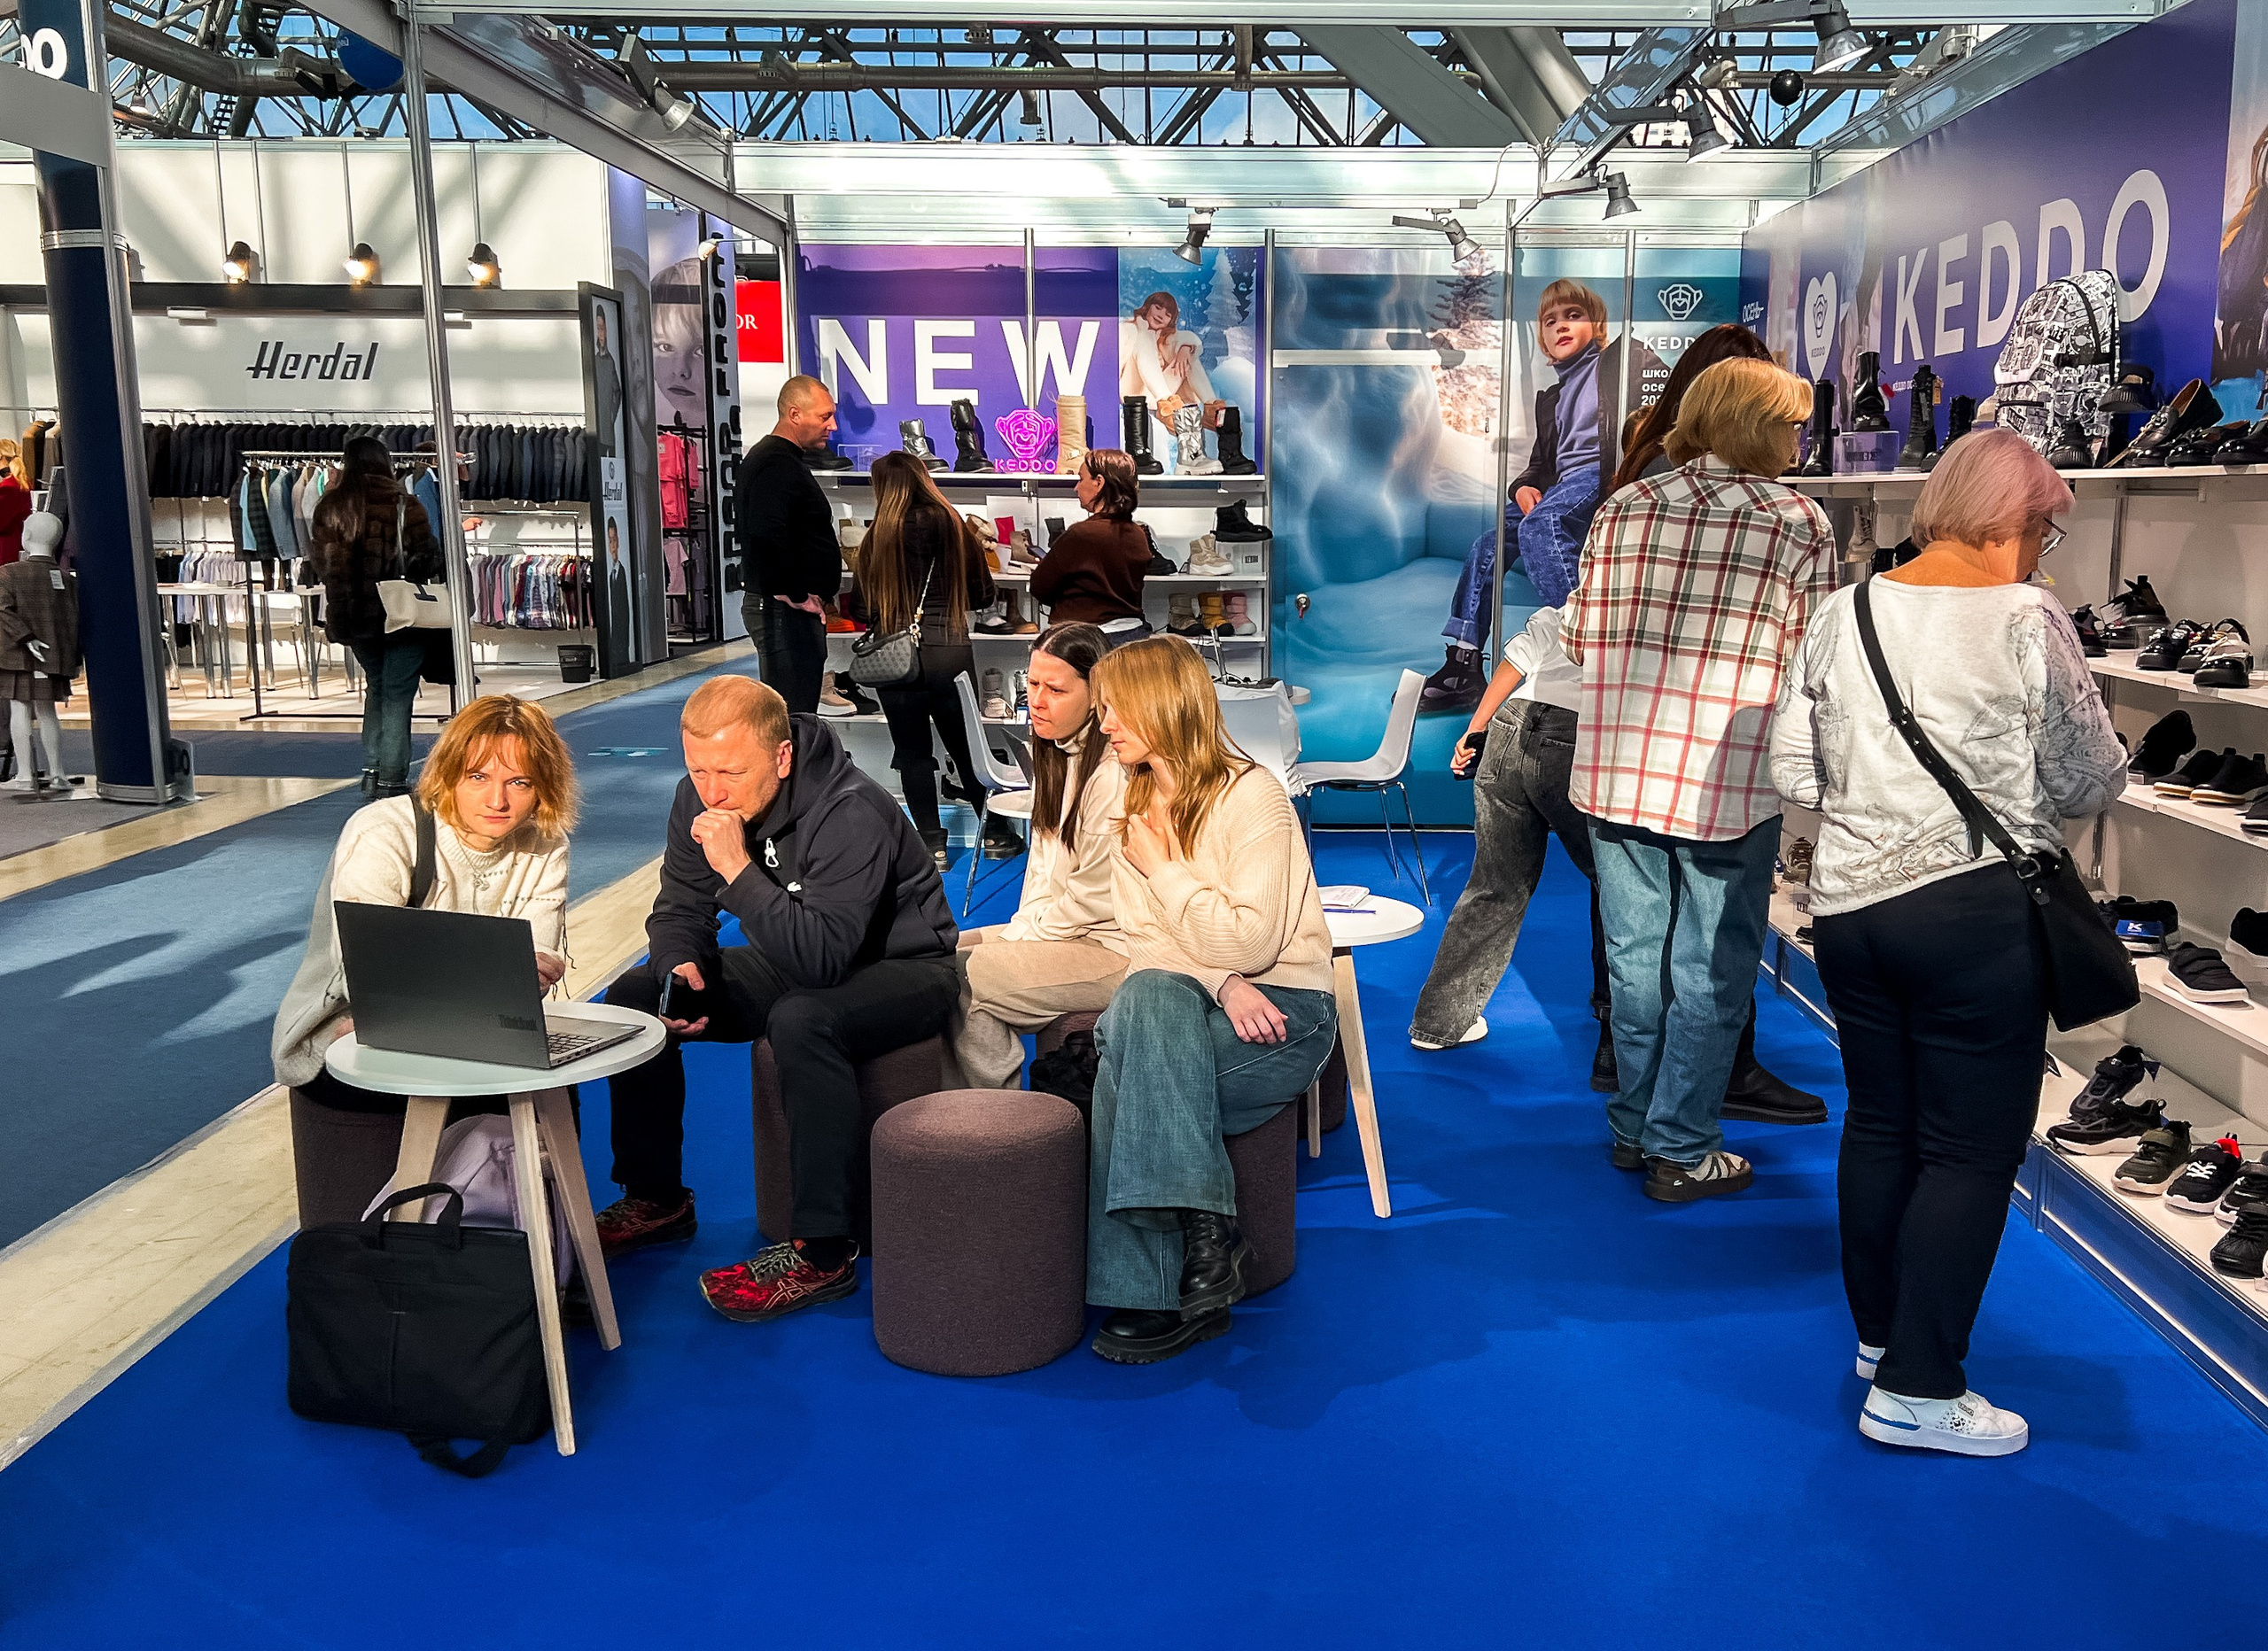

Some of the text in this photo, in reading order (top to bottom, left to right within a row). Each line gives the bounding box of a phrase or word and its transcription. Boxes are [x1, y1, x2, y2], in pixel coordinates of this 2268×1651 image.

[1893, 168, 2170, 365] KEDDO
[245, 340, 380, 381] Herdal
[818, 318, 1100, 407] NEW
[994, 458, 1057, 473] KEDDO
